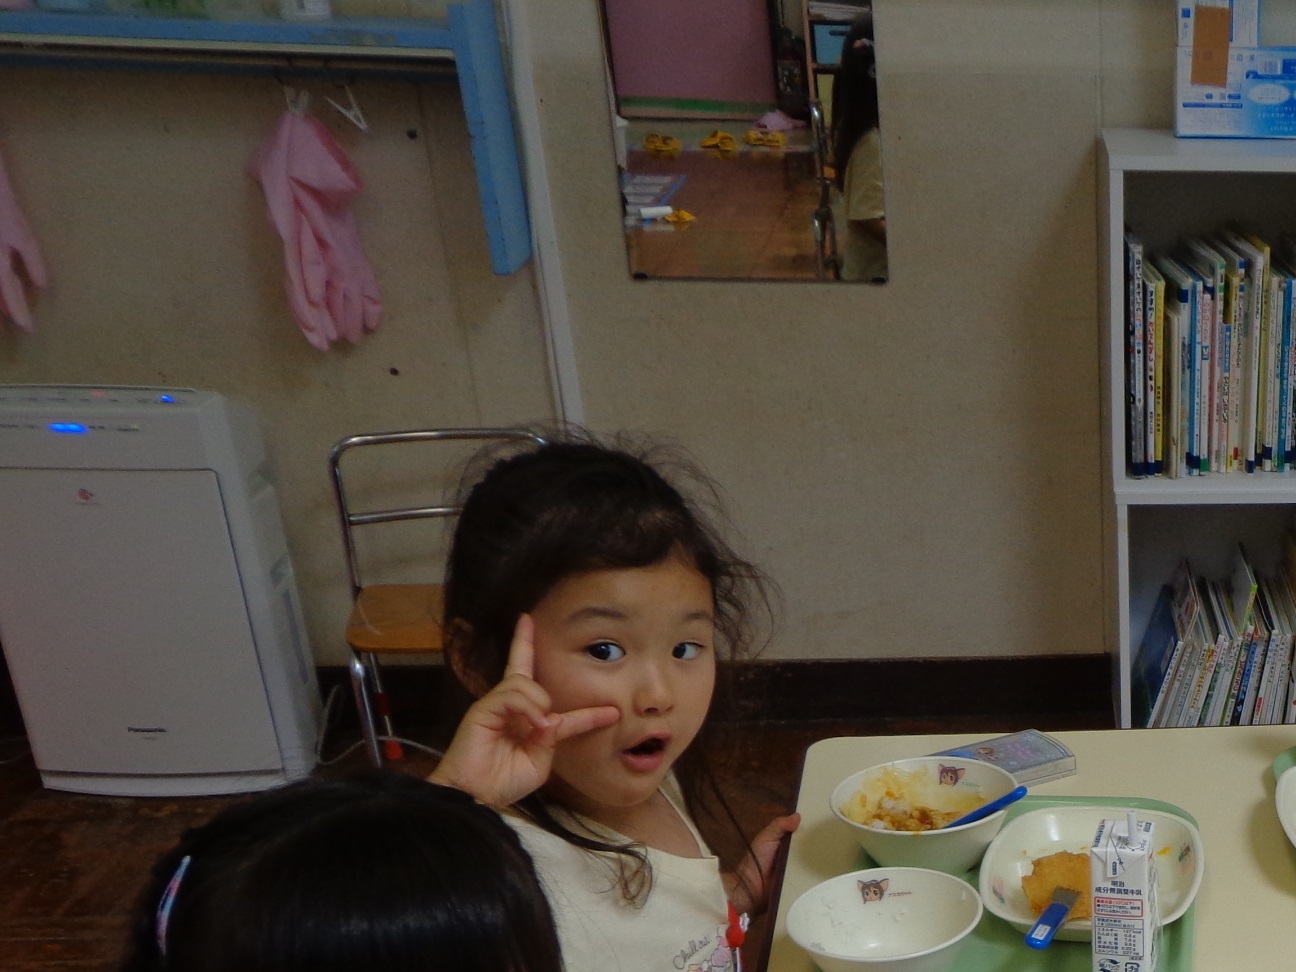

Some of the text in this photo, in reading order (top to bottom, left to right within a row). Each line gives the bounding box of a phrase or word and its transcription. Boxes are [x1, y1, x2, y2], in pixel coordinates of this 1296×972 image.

[1111, 880, 1125, 888] 明治
[1095, 887, 1142, 896] 成分無調整牛乳
